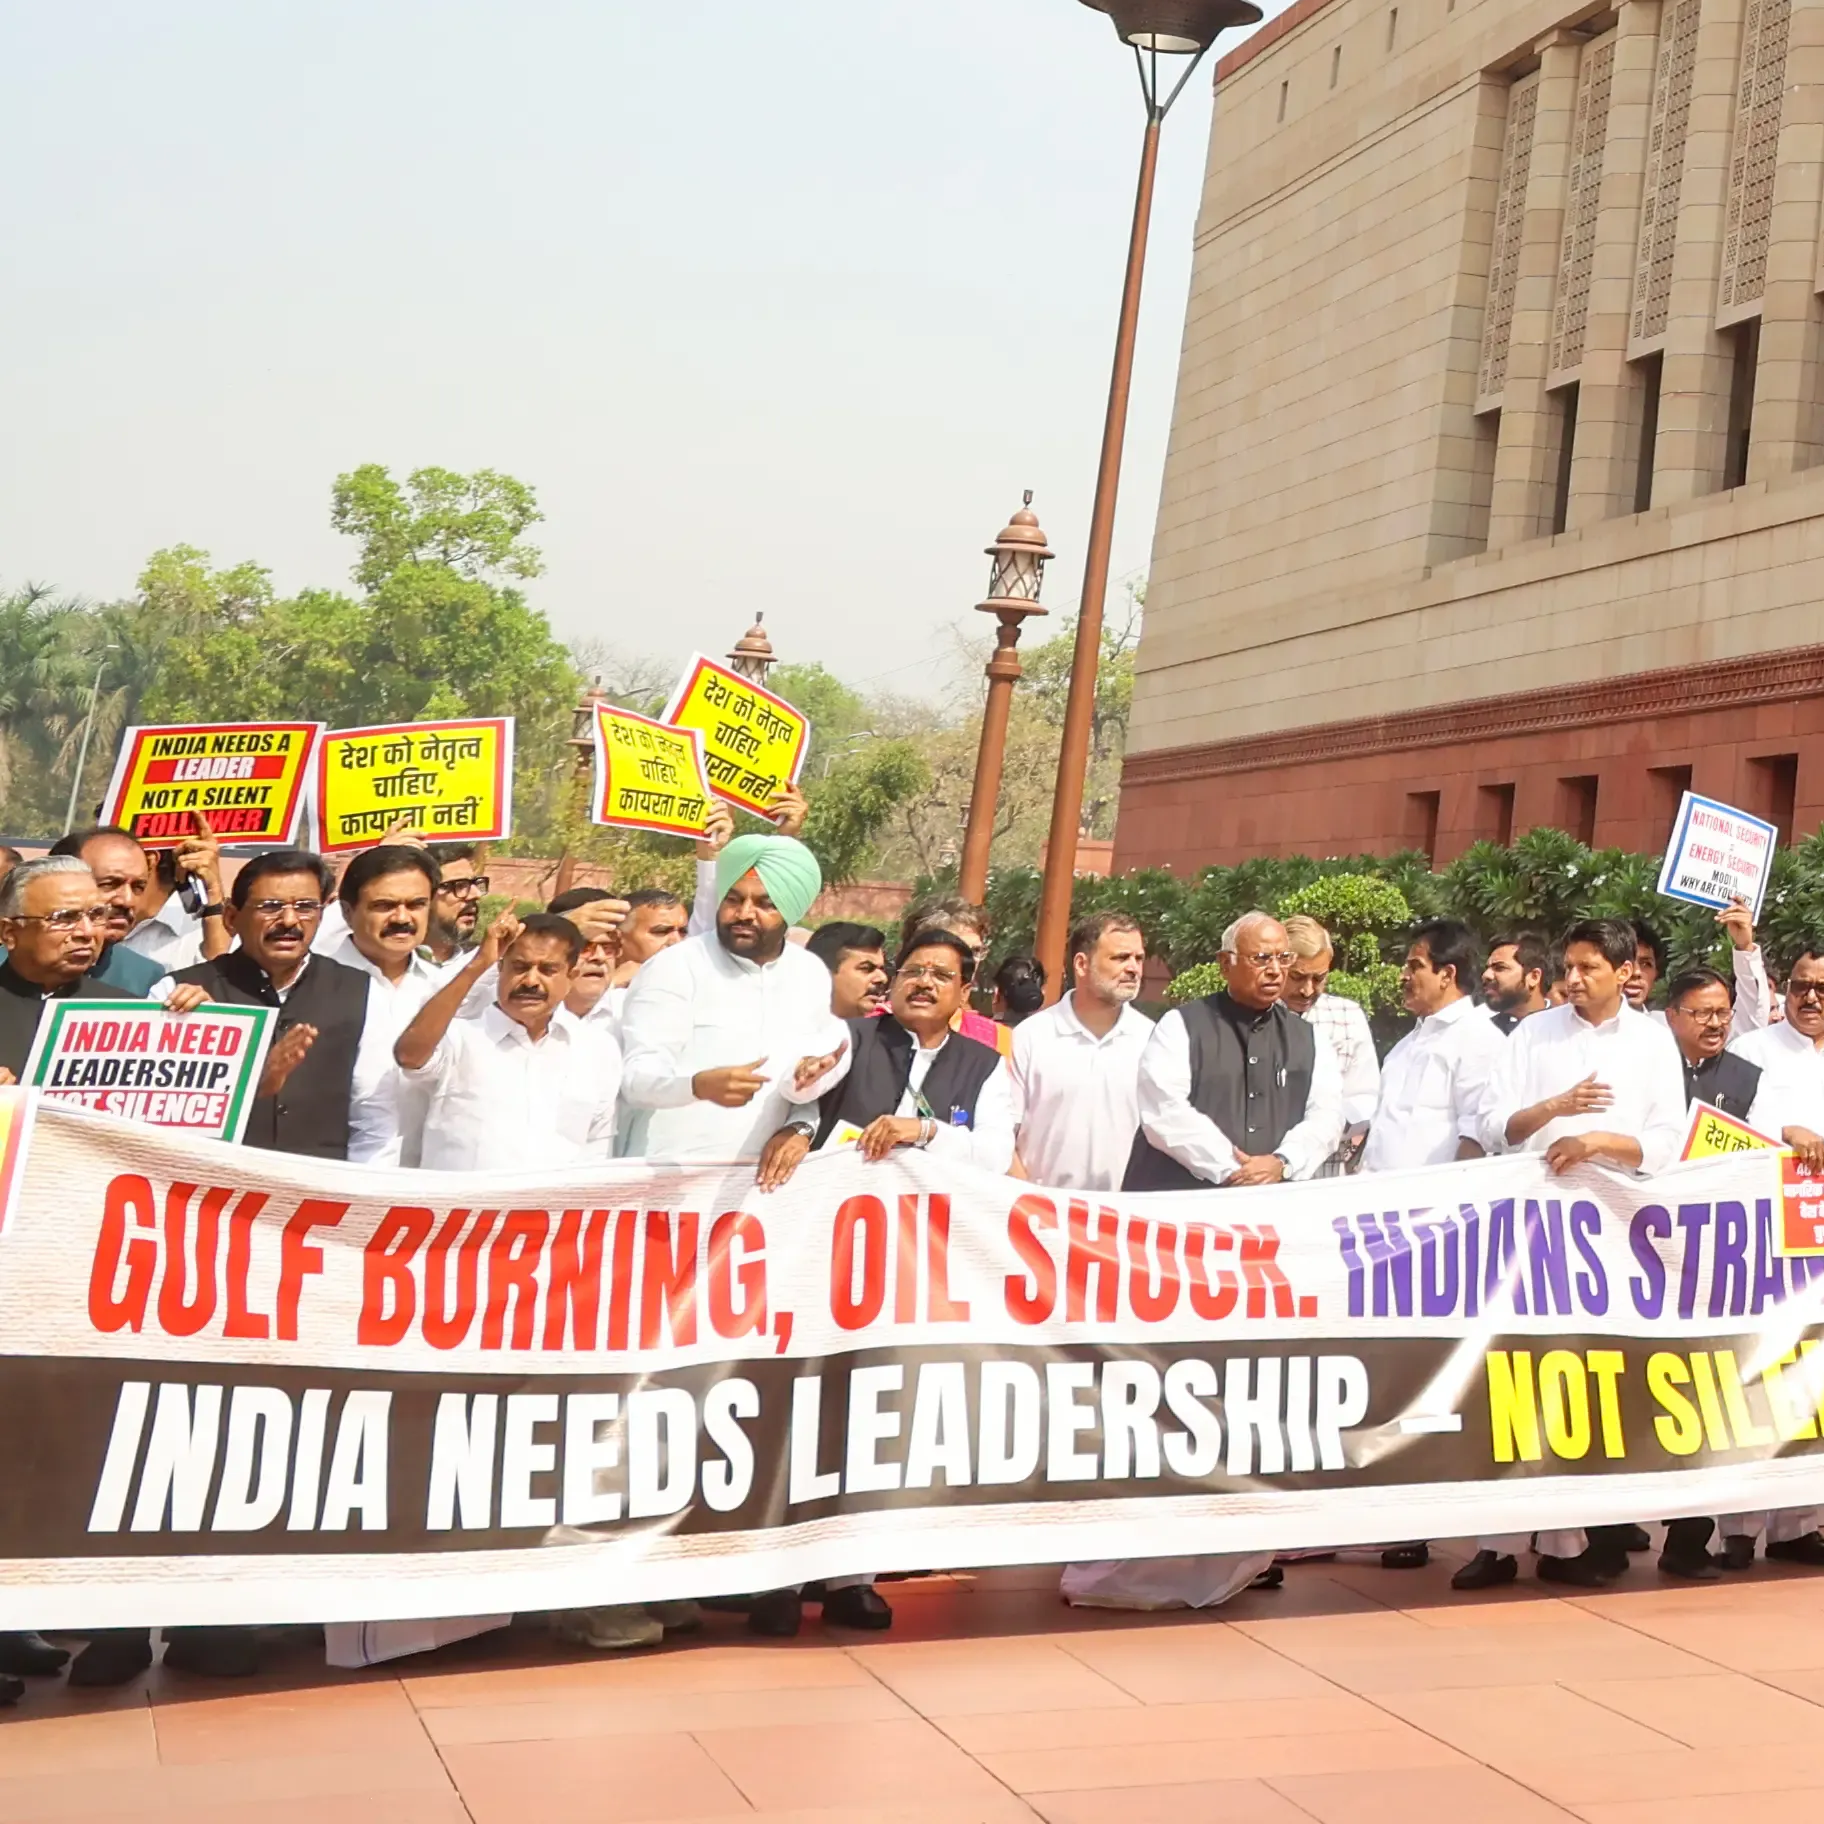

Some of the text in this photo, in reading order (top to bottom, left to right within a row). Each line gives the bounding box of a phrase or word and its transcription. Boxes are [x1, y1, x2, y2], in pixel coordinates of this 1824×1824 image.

[704, 676, 756, 721] देश को
[152, 734, 290, 756] INDIA NEEDS A
[339, 733, 482, 770] देश को नेतृत्व
[172, 757, 255, 781] LEADER
[373, 768, 443, 797] चाहिए,
[141, 786, 272, 809] NOT A SILENT
[432, 796, 483, 826] नहीं
[135, 809, 264, 837] FOLLWER
[1680, 876, 1716, 895] WHY ARE
[62, 1022, 243, 1056] INDIA NEED
[51, 1059, 230, 1093] LEADERSHIP,
[88, 1173, 351, 1341] GULF
[357, 1206, 795, 1355] BURNING,
[830, 1193, 970, 1330] OIL
[1332, 1198, 1610, 1318] INDIANS
[88, 1380, 393, 1533] INDIA
[425, 1377, 760, 1530] NEEDS
[788, 1354, 1369, 1505] LEADERSHIP
[1486, 1349, 1625, 1462] NOT
